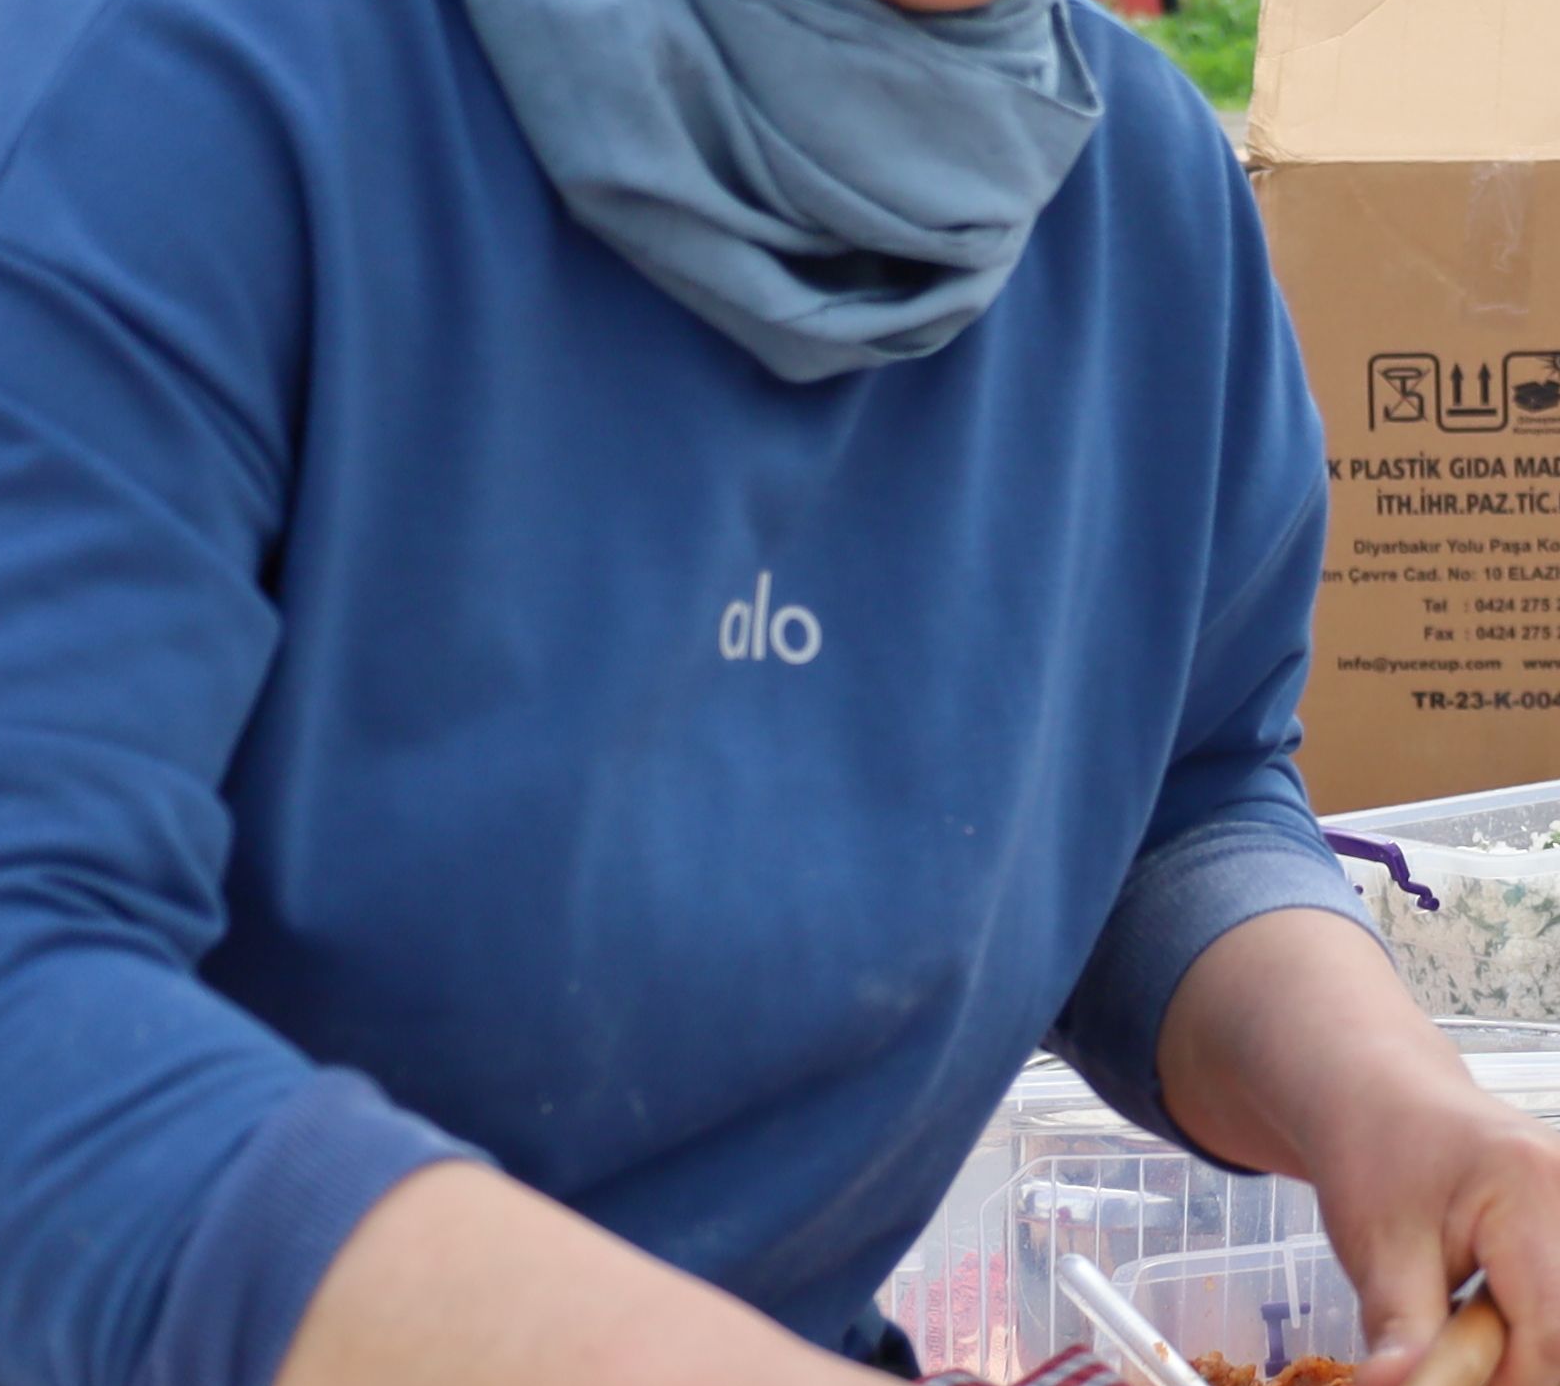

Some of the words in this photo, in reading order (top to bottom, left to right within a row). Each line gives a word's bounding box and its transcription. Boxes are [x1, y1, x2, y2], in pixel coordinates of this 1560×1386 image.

[1351, 452, 1440, 480] PLASTİK
[1449, 458, 1506, 479] GIDA
[1353, 538, 1440, 557] Diyarbakır
[1447, 538, 1484, 554] Yolu
[1490, 538, 1532, 556] Paşa
[1348, 567, 1397, 584] Çevre
[1448, 567, 1477, 582] No:
[1484, 567, 1502, 581] 10
[1423, 598, 1448, 613] Tel
[1475, 598, 1515, 612] 0424
[1520, 597, 1551, 612] 275
[1424, 626, 1455, 641] Fax
[1476, 626, 1516, 640] 0424
[1521, 626, 1551, 640] 275
